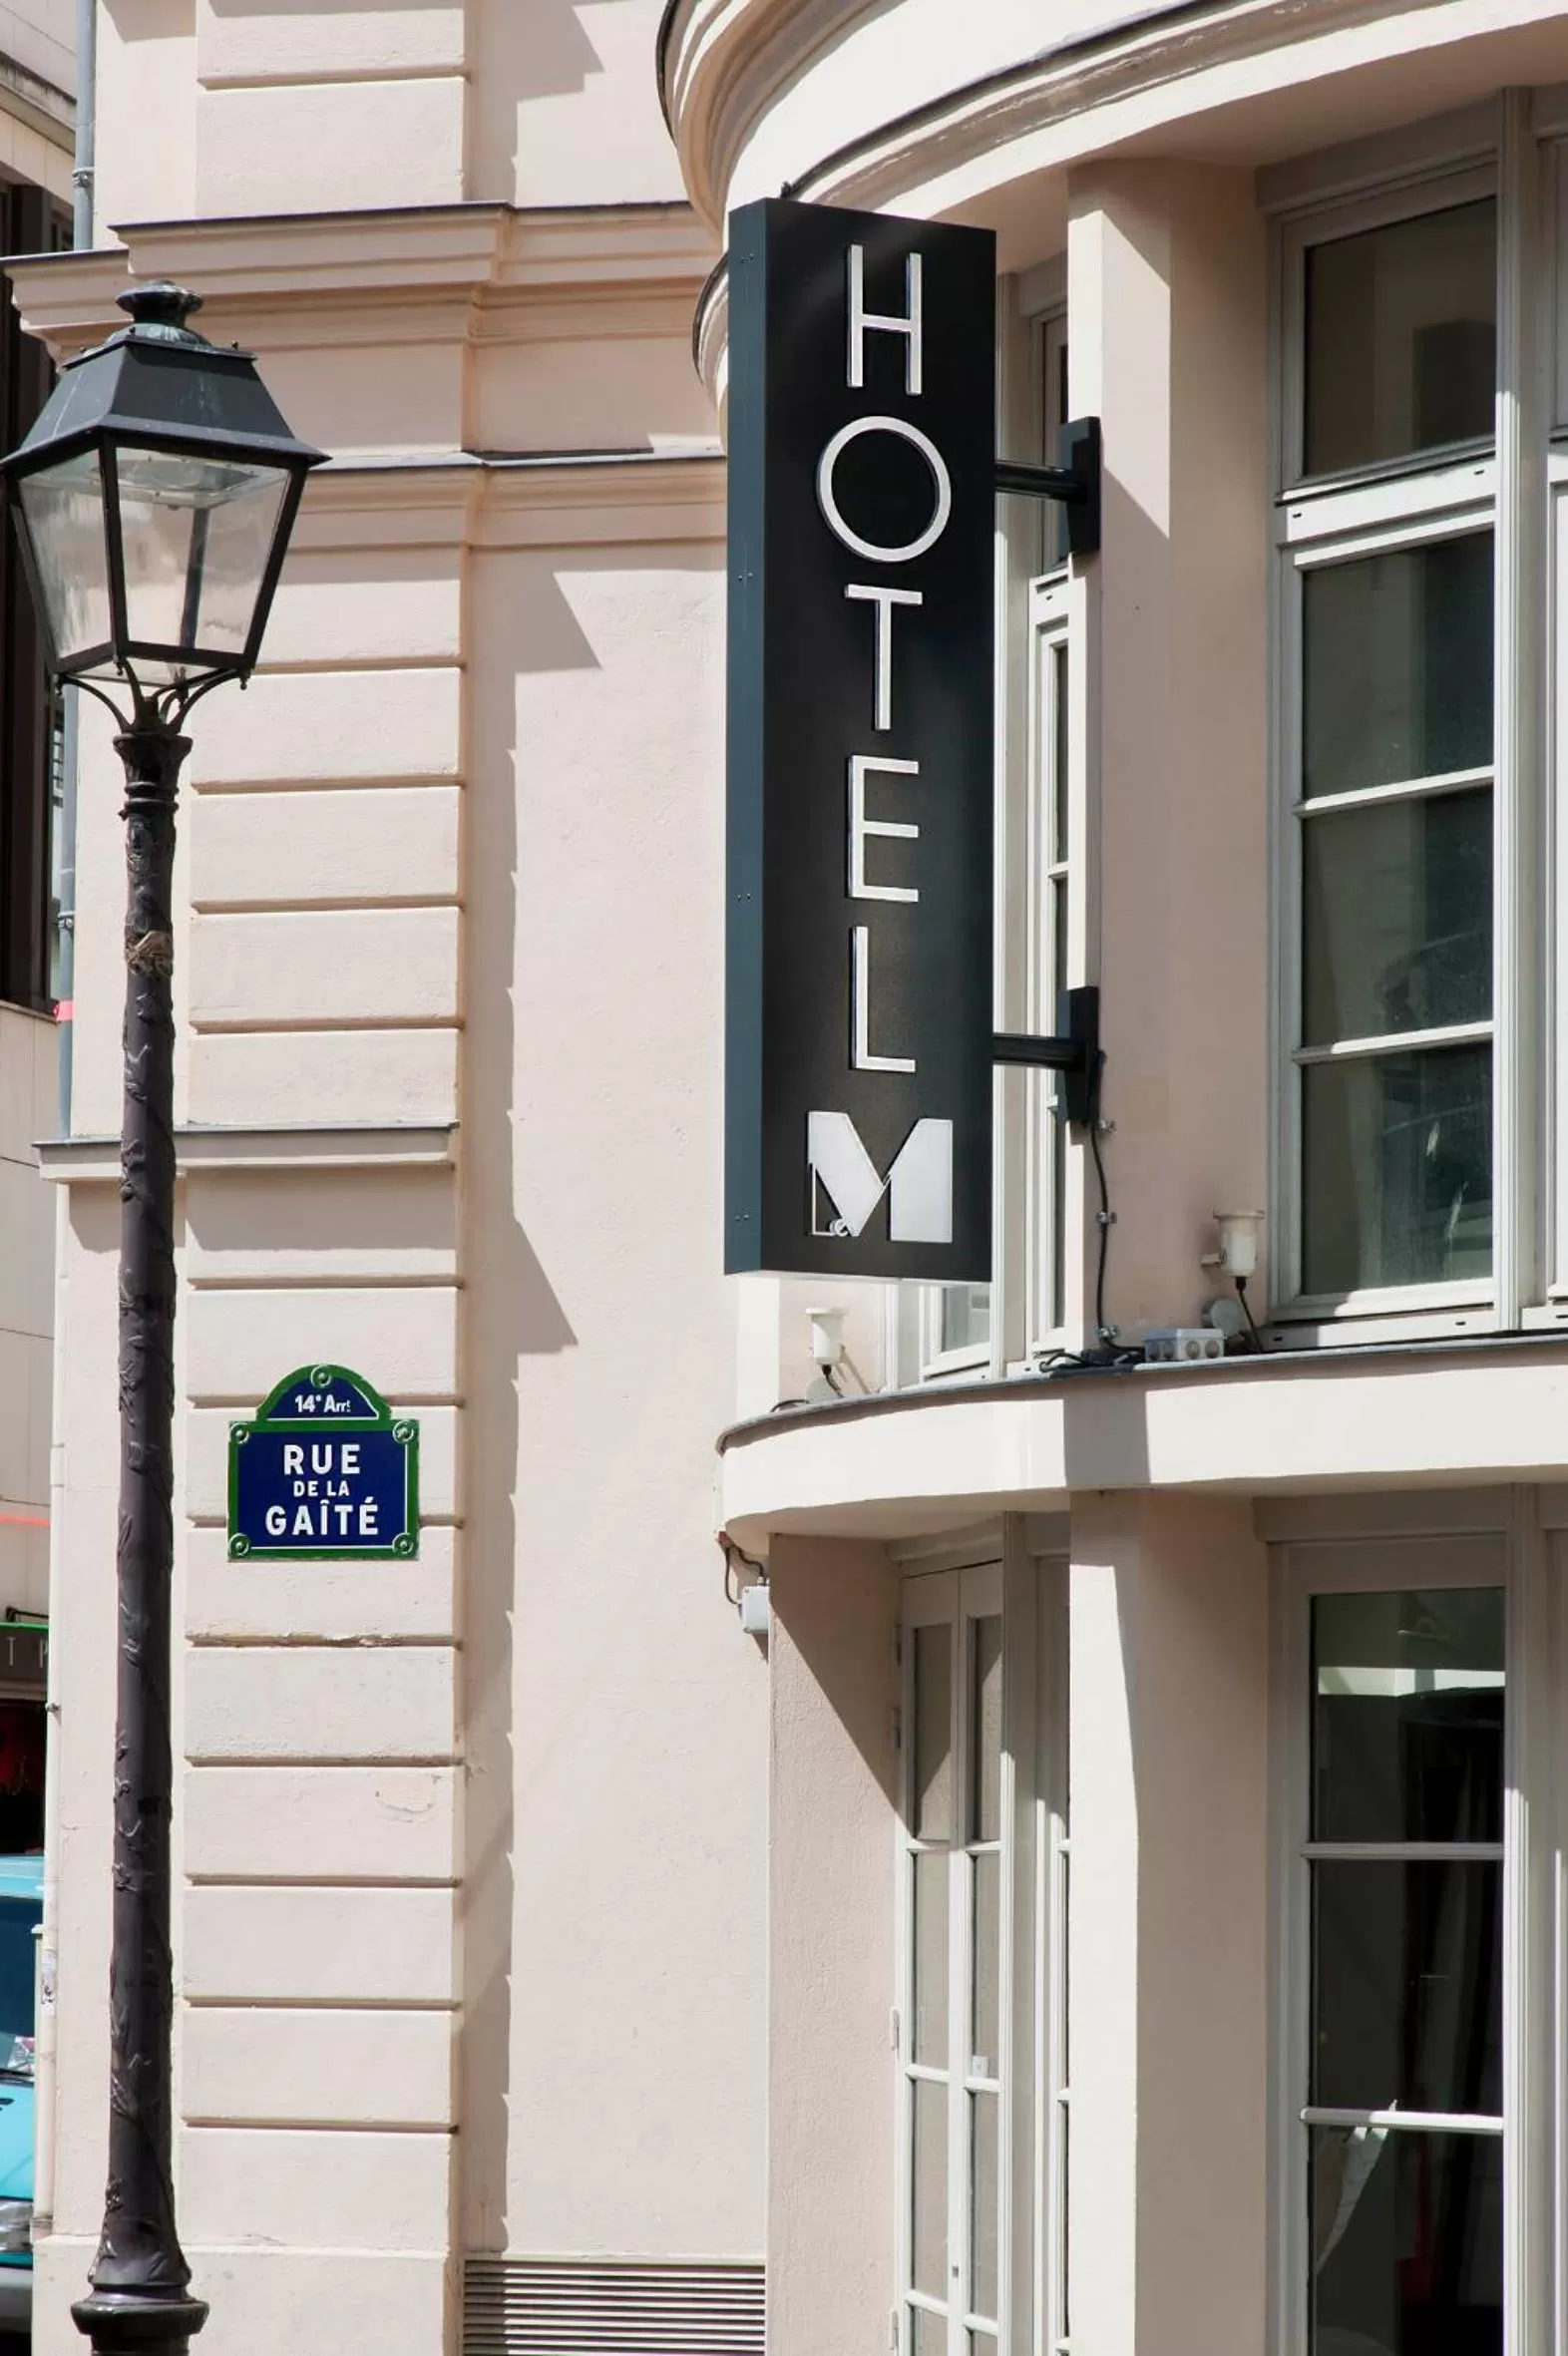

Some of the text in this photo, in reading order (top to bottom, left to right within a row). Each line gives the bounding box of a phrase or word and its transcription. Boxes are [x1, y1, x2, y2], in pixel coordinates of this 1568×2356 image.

[816, 244, 952, 1072] HOTEL
[283, 1443, 361, 1475] RUE
[293, 1480, 350, 1497] DE LA
[265, 1496, 379, 1536] GAÎTÉ
